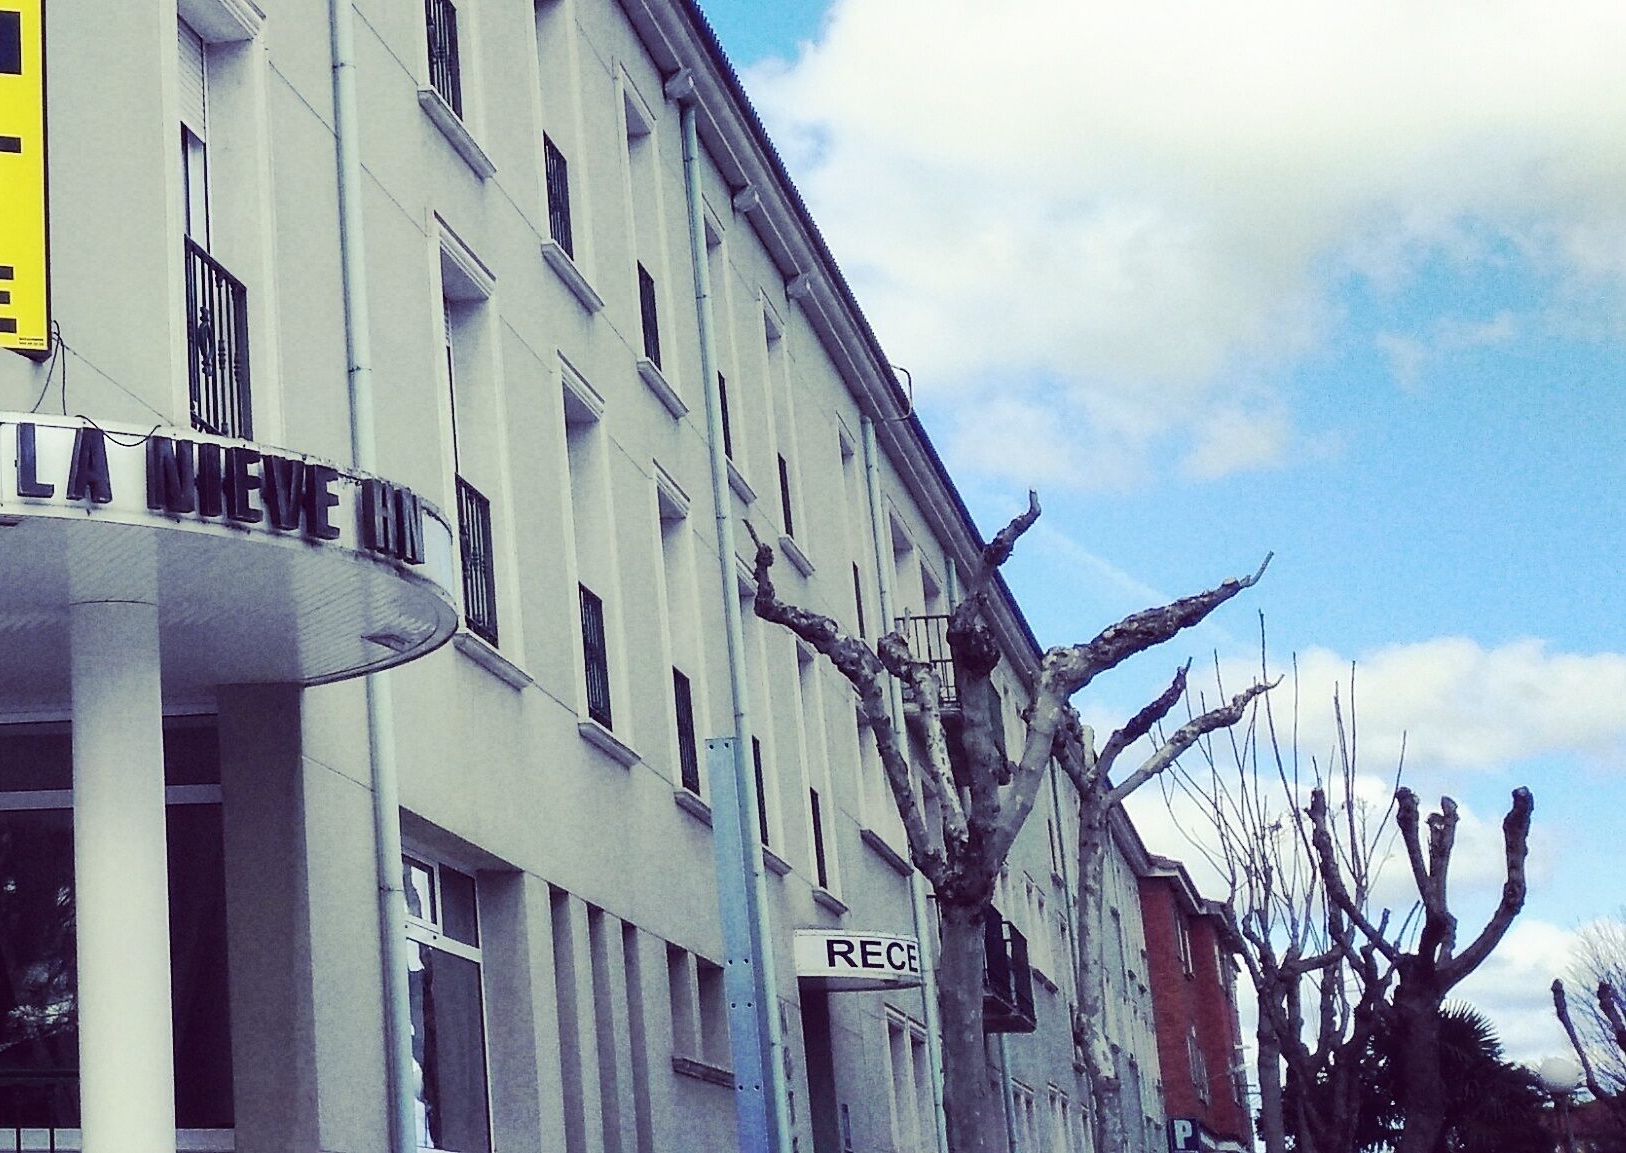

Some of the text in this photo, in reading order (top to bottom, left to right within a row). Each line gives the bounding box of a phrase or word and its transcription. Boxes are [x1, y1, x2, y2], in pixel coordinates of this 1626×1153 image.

[15, 421, 113, 504] LA
[144, 434, 341, 540] NIEVE
[826, 939, 919, 973] RECE
[1173, 1119, 1193, 1150] P
